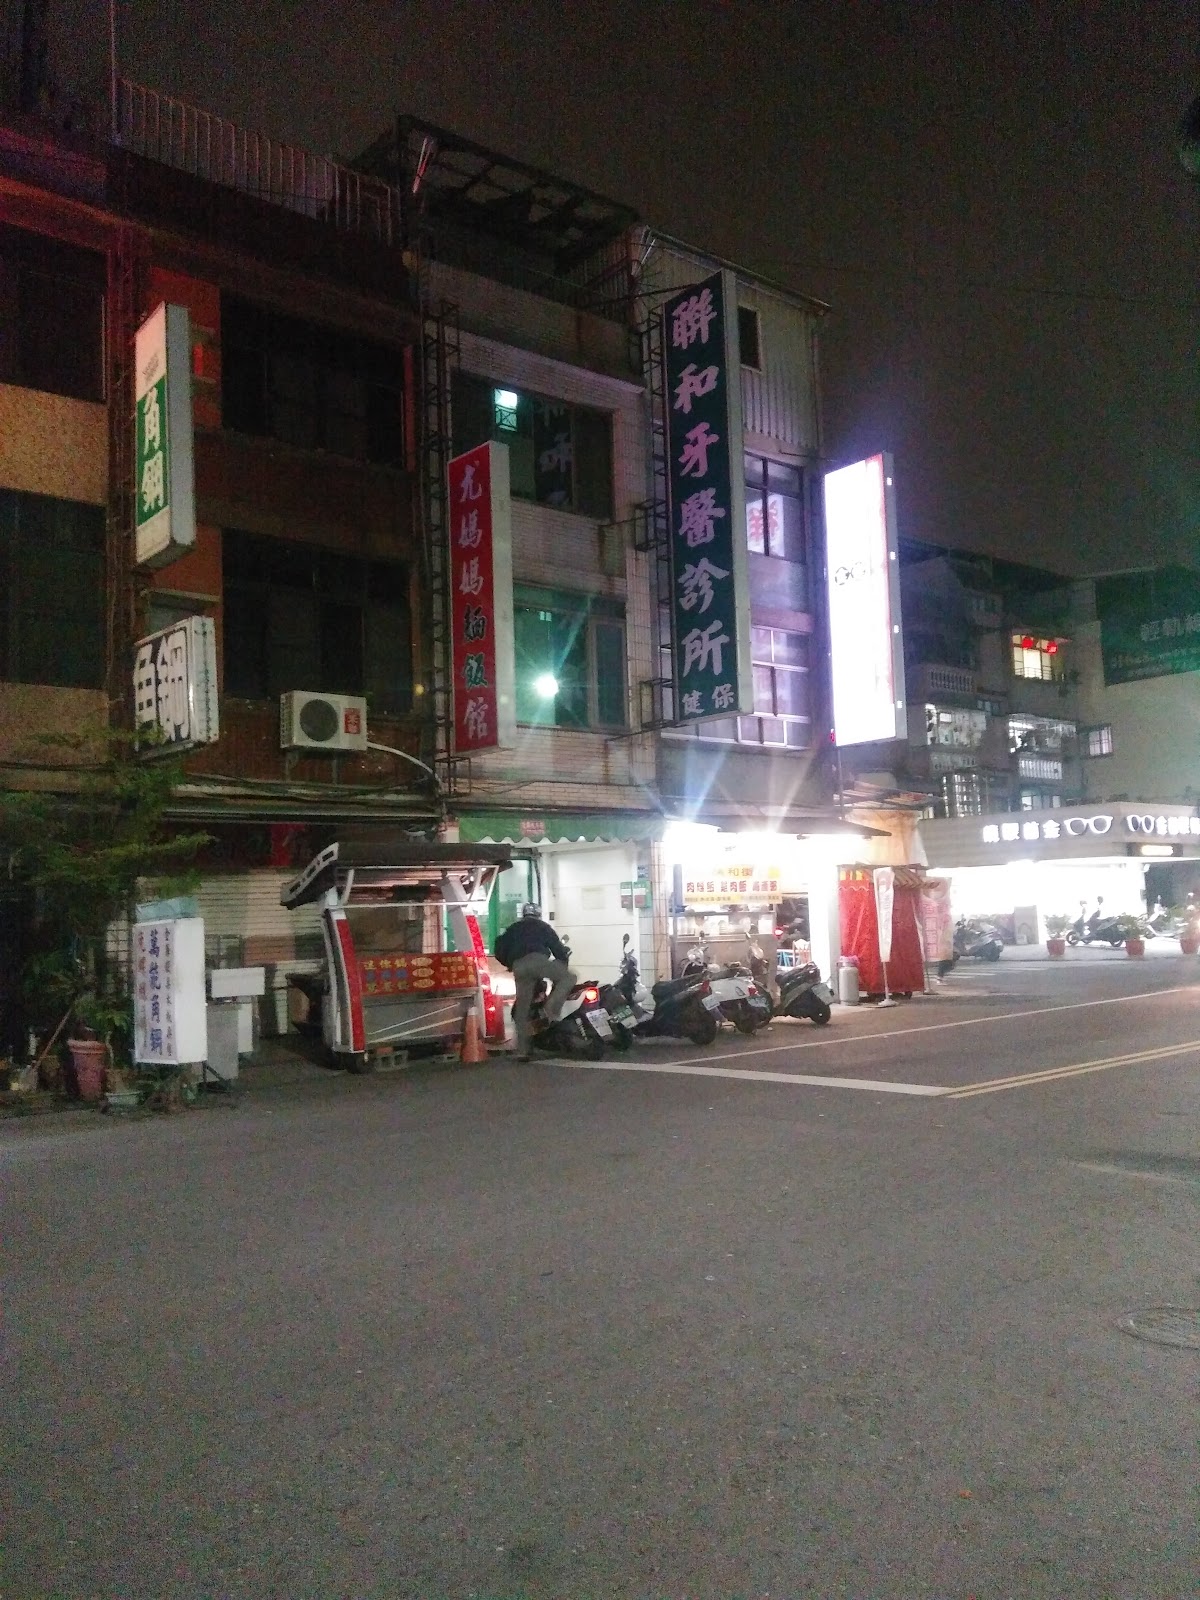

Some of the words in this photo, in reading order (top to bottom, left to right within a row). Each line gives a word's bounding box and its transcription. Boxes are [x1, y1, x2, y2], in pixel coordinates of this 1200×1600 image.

[458, 460, 488, 741] 尤媽媽麵飯館
[671, 288, 730, 678] 聯和牙醫診所
[682, 683, 735, 715] 健保
